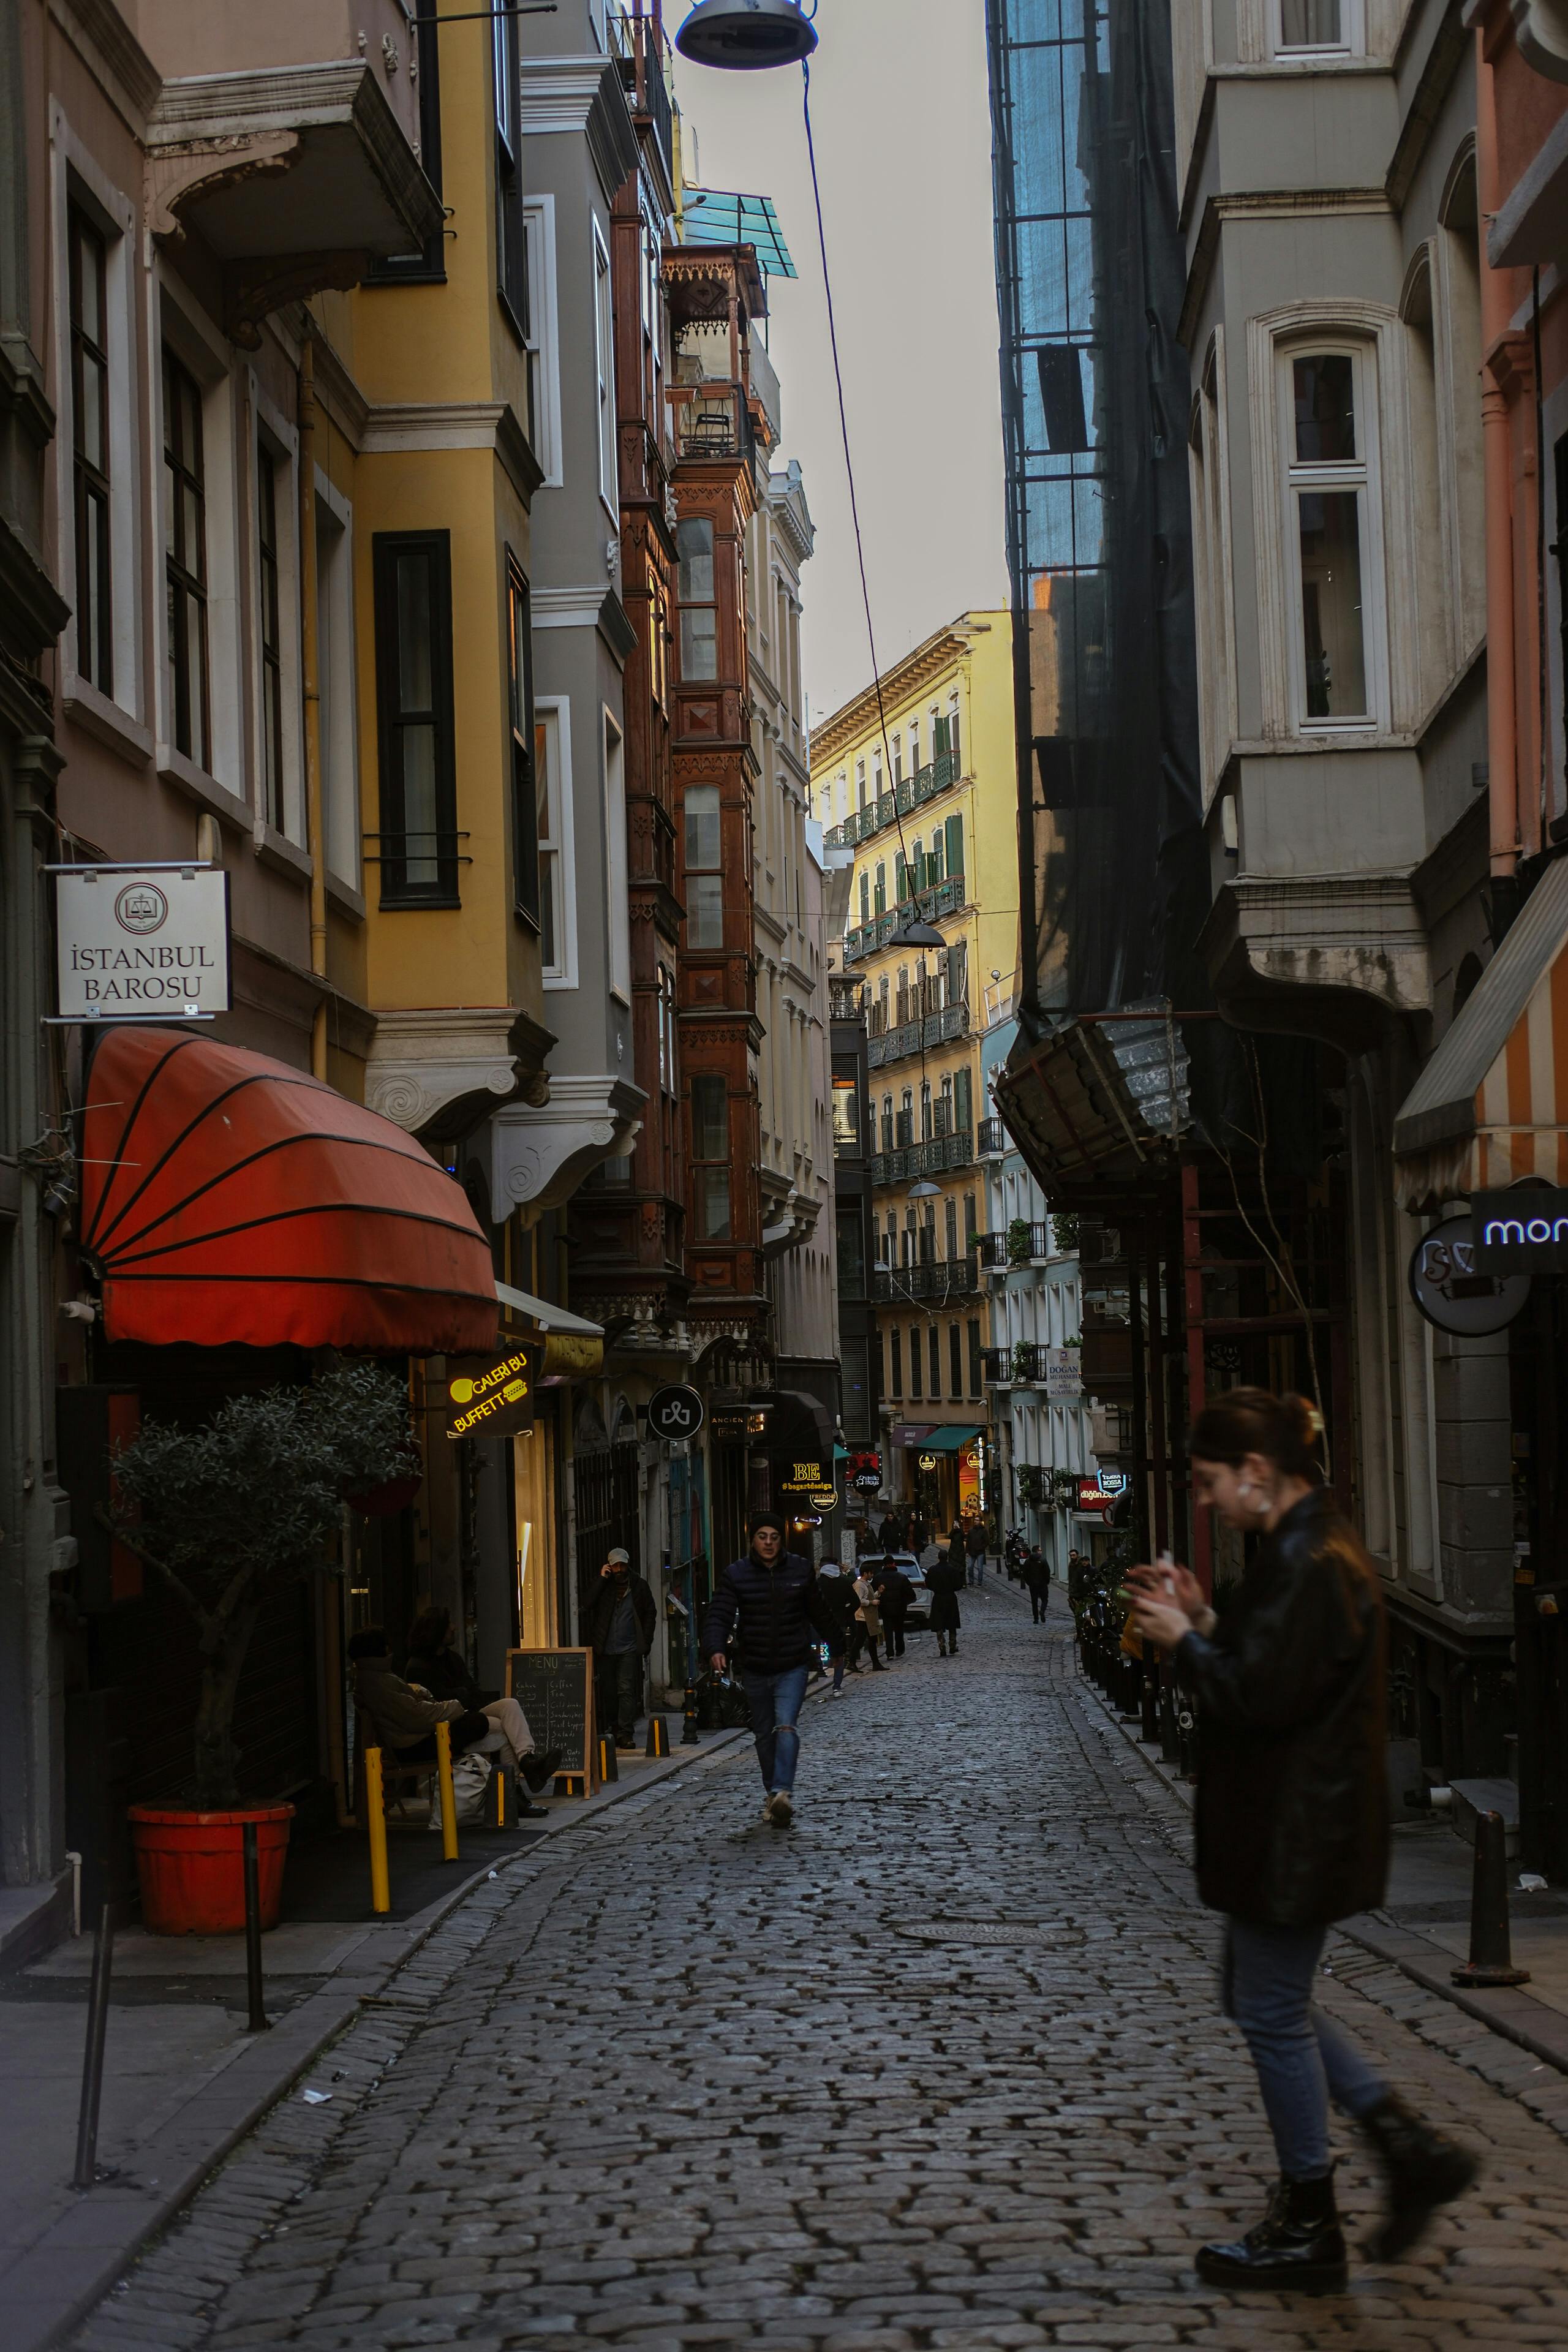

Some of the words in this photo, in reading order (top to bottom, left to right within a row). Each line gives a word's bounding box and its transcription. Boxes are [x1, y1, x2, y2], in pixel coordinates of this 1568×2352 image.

[70, 944, 214, 970] İSTANBUL
[83, 976, 203, 1000] BAROSU
[472, 1362, 511, 1394] GALERİ
[508, 1352, 527, 1371] BU
[1049, 1365, 1079, 1373] DOĞAN
[453, 1392, 505, 1432] BUFFETT
[793, 1463, 820, 1481] BE
